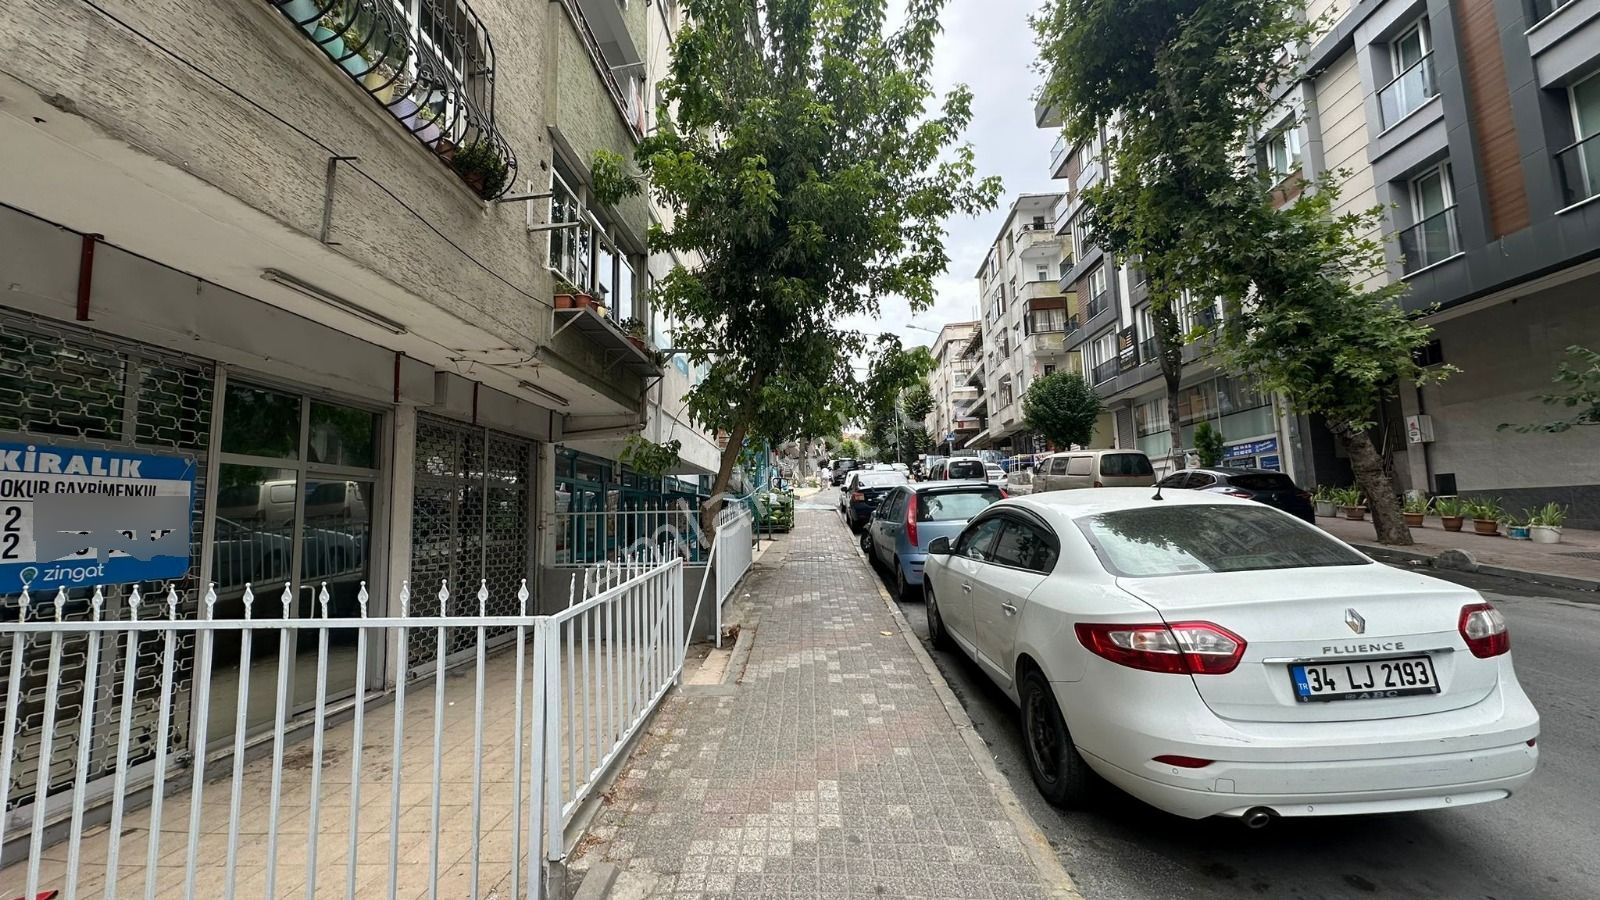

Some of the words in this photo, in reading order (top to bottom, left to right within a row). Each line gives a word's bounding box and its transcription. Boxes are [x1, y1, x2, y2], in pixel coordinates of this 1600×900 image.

[0, 445, 142, 478] KİRALIK
[0, 479, 50, 498] OKUR
[42, 563, 105, 583] zingat
[1322, 641, 1405, 655] FLUENCE
[1307, 668, 1336, 692] 34
[1345, 665, 1375, 690] LJ
[1380, 661, 1430, 688] 2193
[1297, 682, 1309, 691] TR
